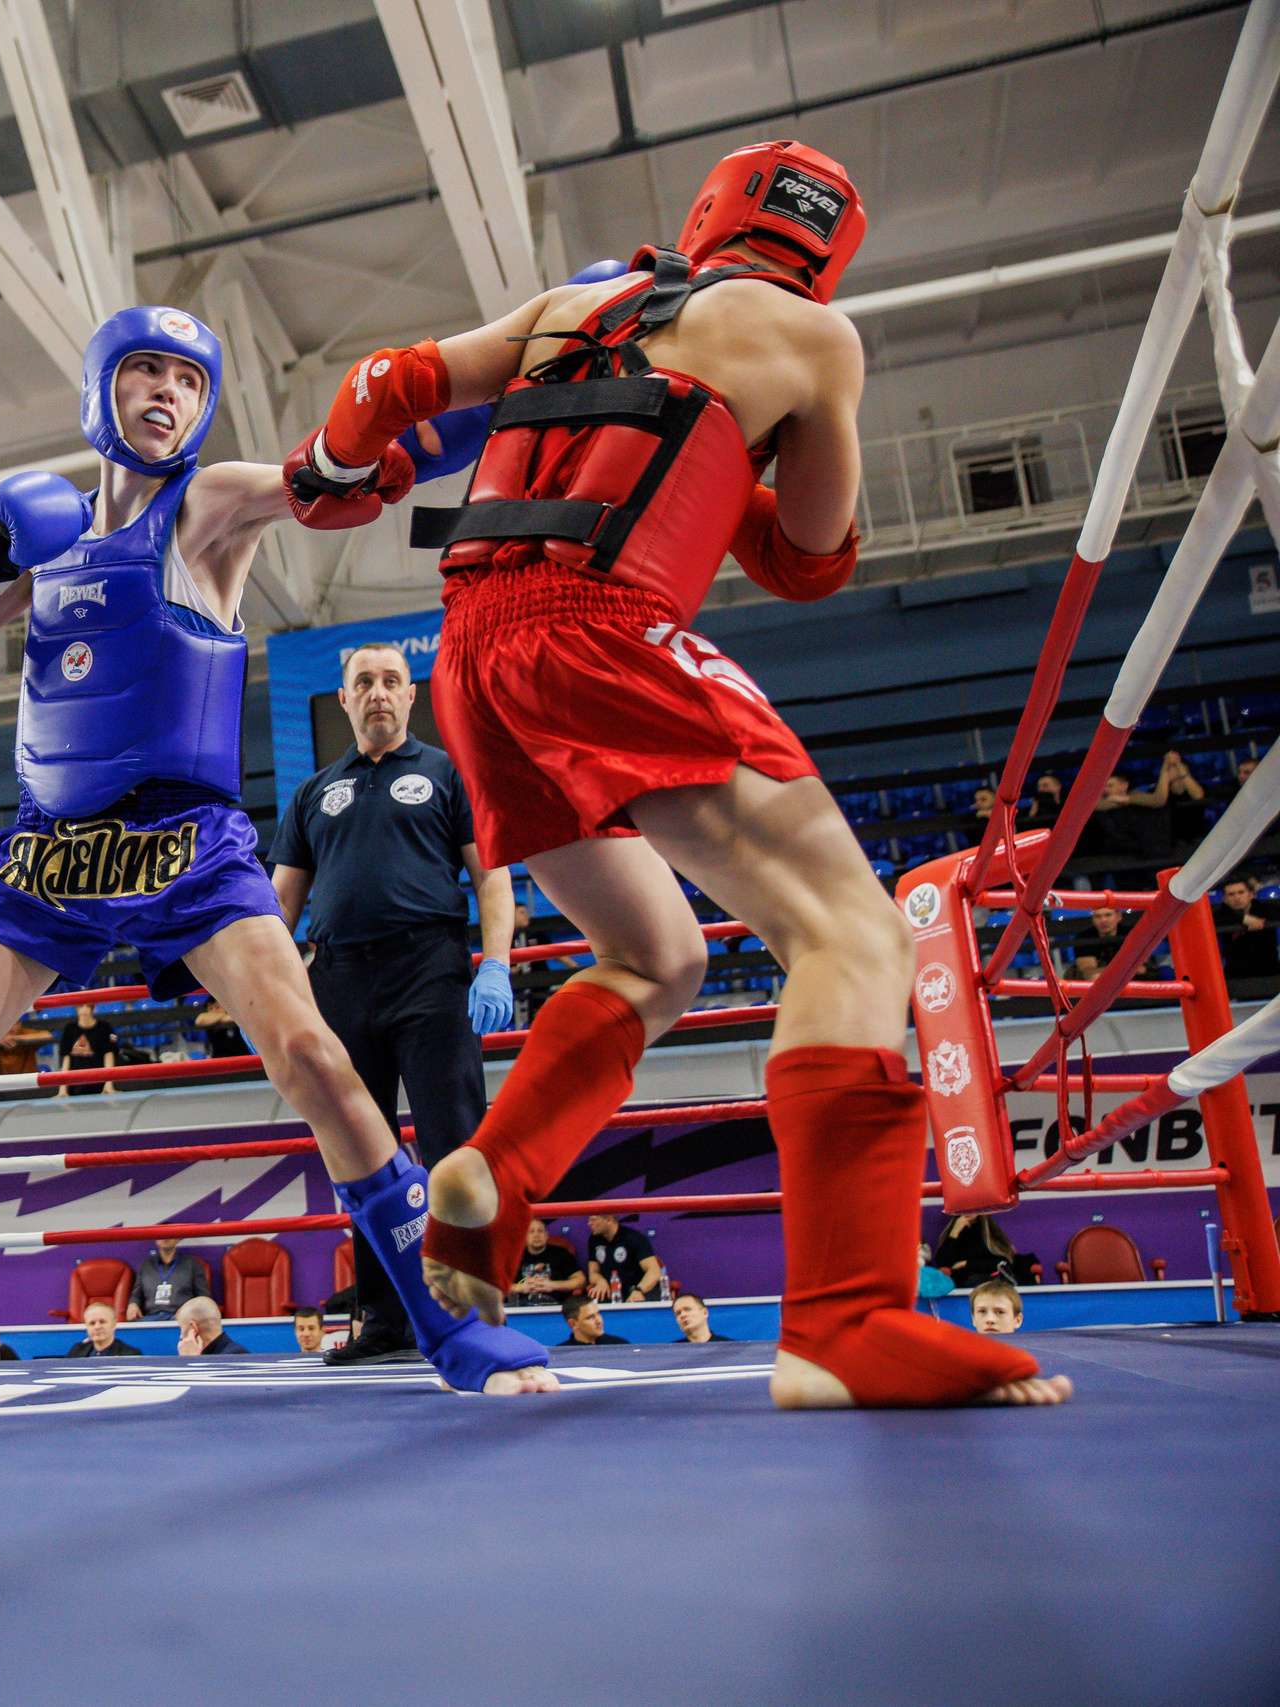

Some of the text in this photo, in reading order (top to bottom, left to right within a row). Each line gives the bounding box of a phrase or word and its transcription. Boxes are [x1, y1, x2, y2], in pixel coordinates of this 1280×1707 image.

[766, 203, 793, 216] BOXING
[775, 177, 841, 217] REWEL
[58, 581, 107, 611] REWEL
[1010, 1103, 1280, 1164] FONBT
